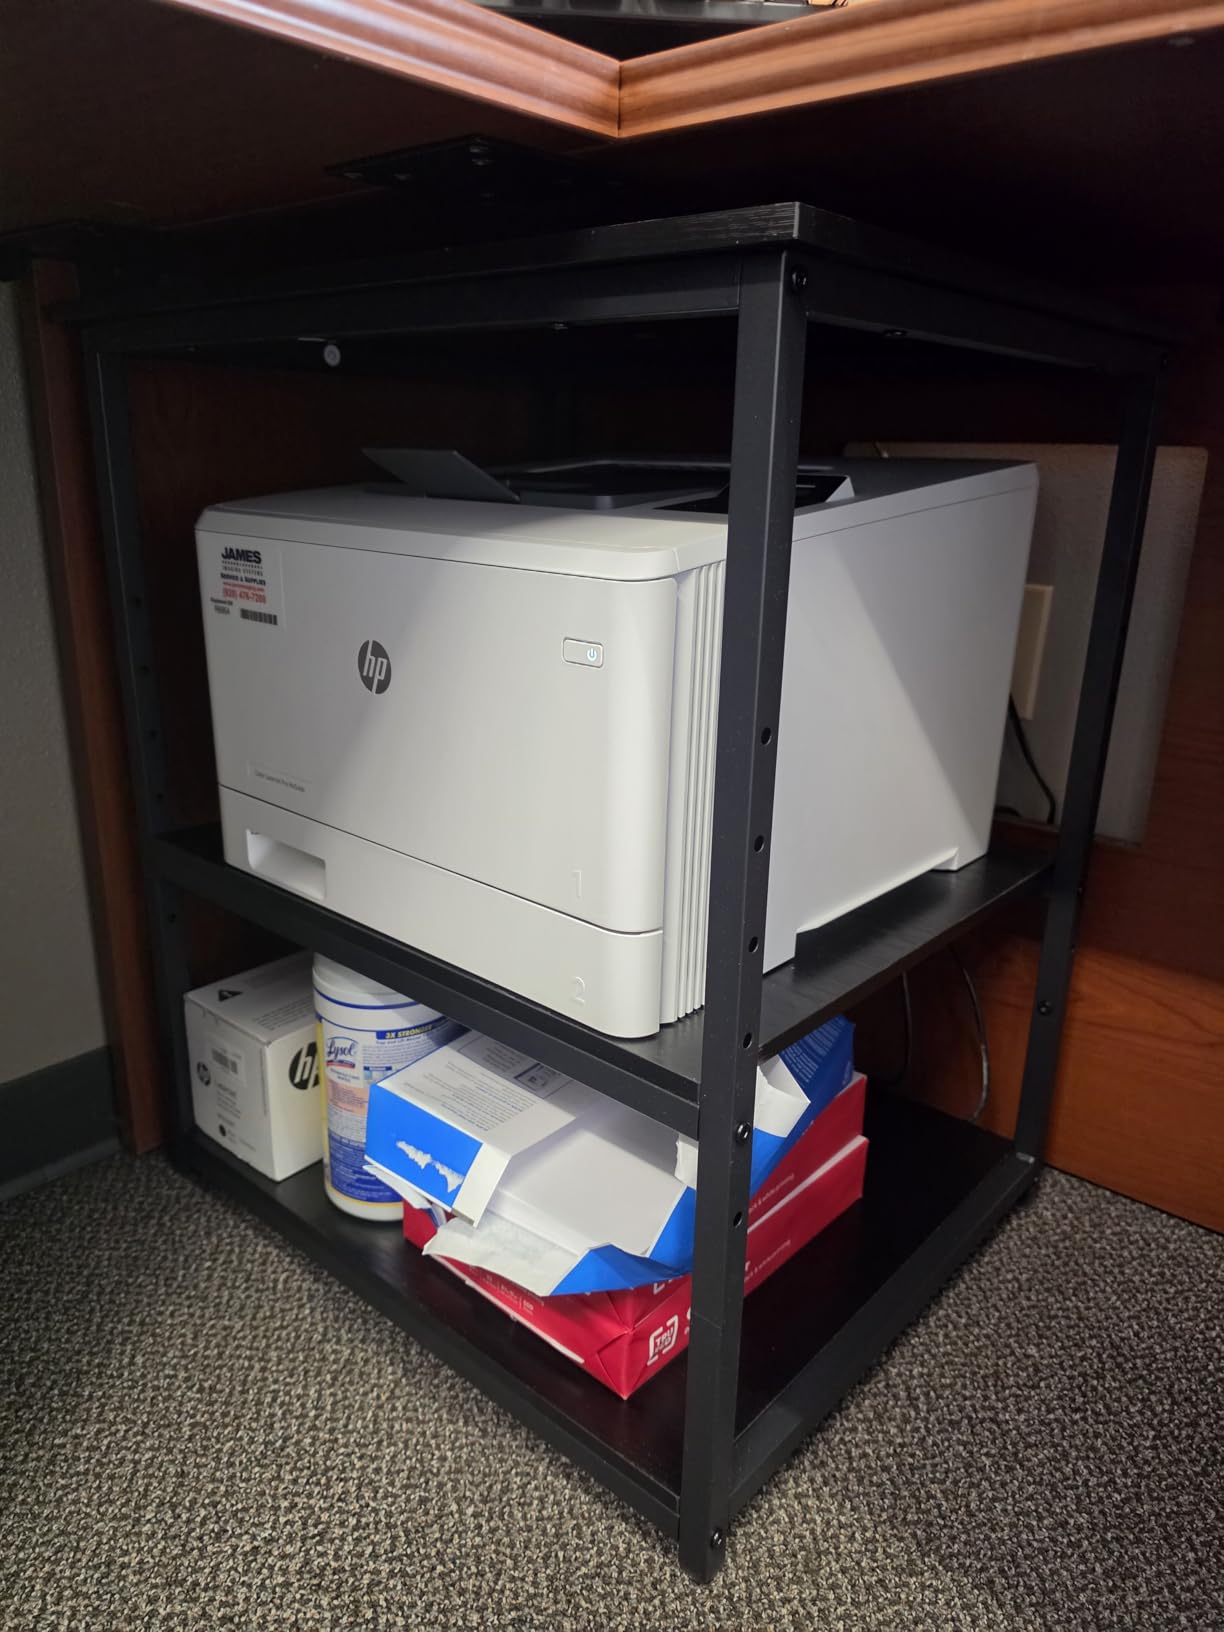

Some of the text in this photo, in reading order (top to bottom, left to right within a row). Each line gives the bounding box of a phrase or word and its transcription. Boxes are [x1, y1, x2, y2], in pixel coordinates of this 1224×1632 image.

[221, 547, 262, 563] JAMES
[359, 640, 391, 695] hp
[327, 1039, 354, 1060] Lysol
[656, 1327, 674, 1347] TRU
